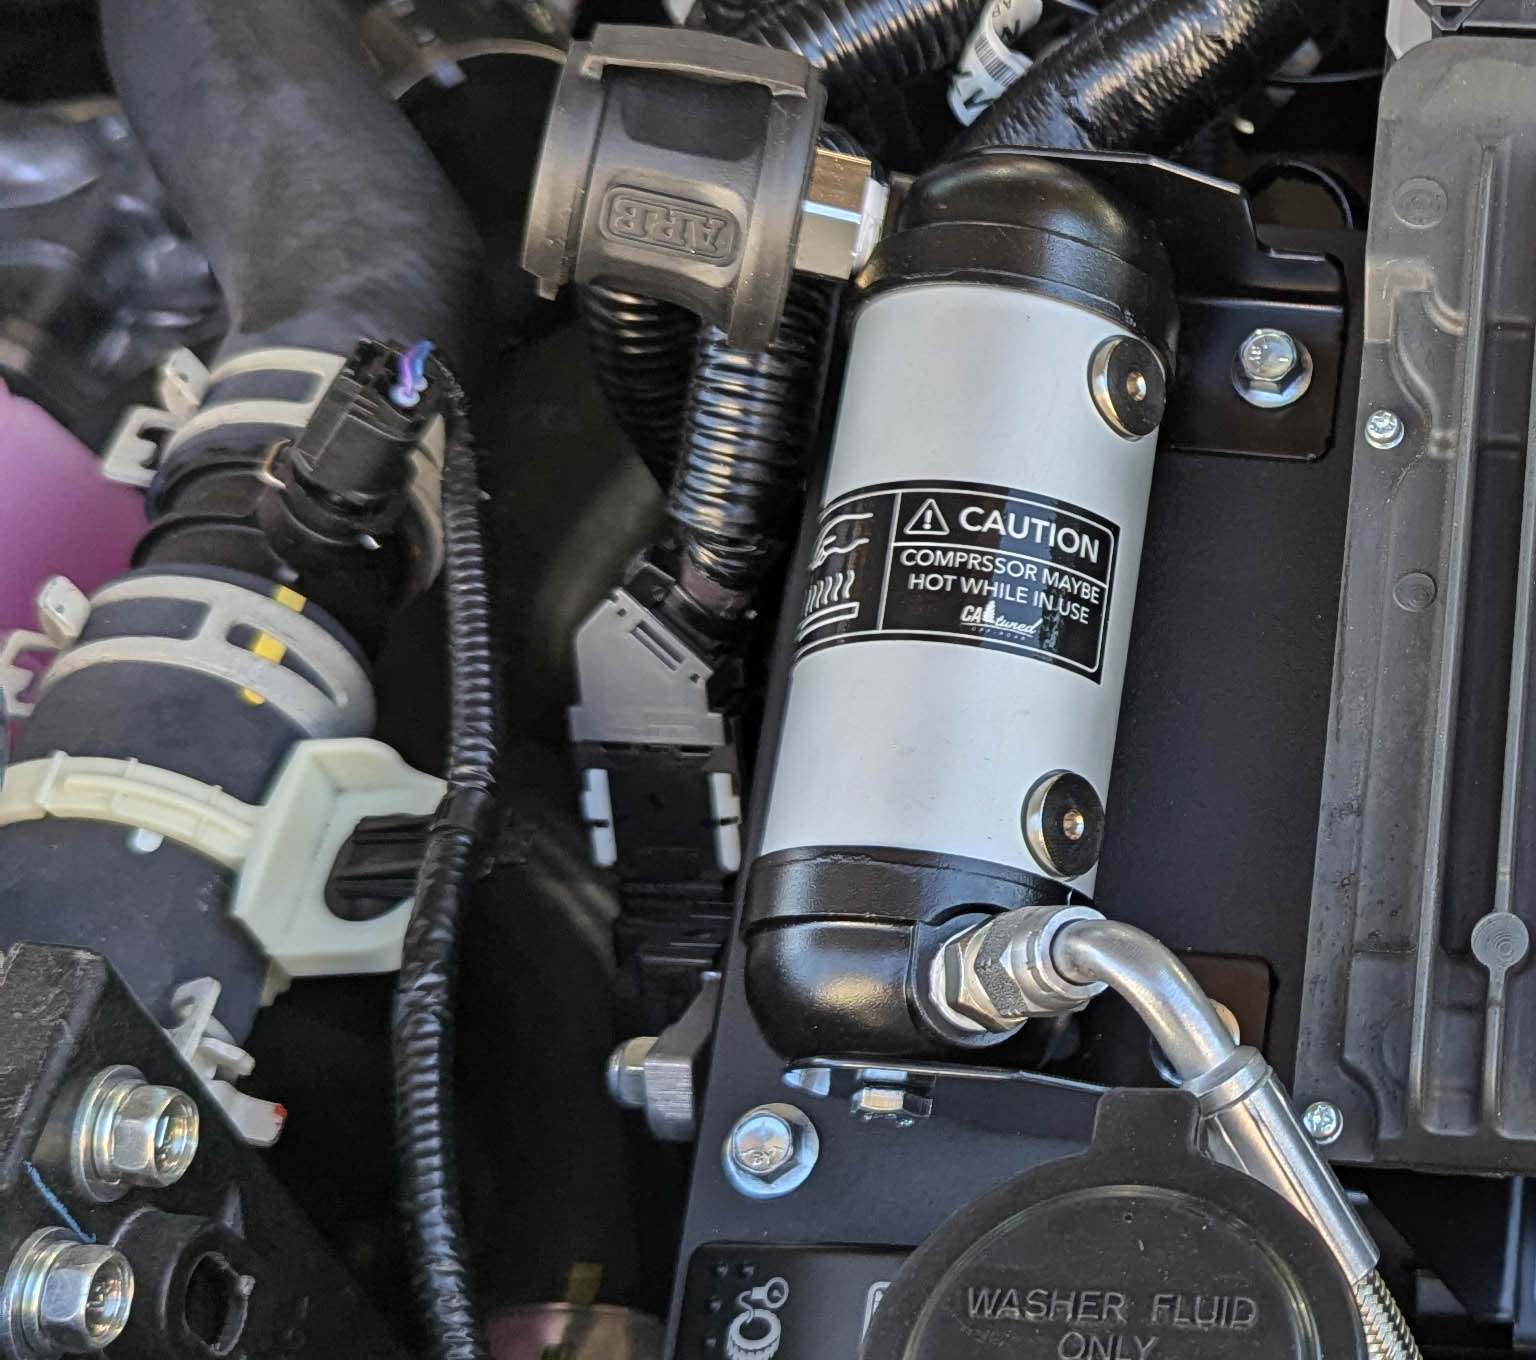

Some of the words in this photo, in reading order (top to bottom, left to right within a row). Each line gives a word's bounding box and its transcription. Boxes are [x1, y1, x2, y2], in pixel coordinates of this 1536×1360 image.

[614, 198, 728, 256] ARB
[959, 506, 1099, 563] CAUTION
[900, 548, 1037, 582] COMPRSSOR
[1042, 568, 1100, 605] MAYBE
[908, 573, 957, 591] HOT
[960, 576, 1028, 604] WHILE
[1033, 590, 1053, 611] IN
[1059, 599, 1090, 625] USE
[994, 615, 1043, 634] tuned
[968, 1286, 1127, 1325] WASHER
[1151, 1293, 1259, 1330] FLUID
